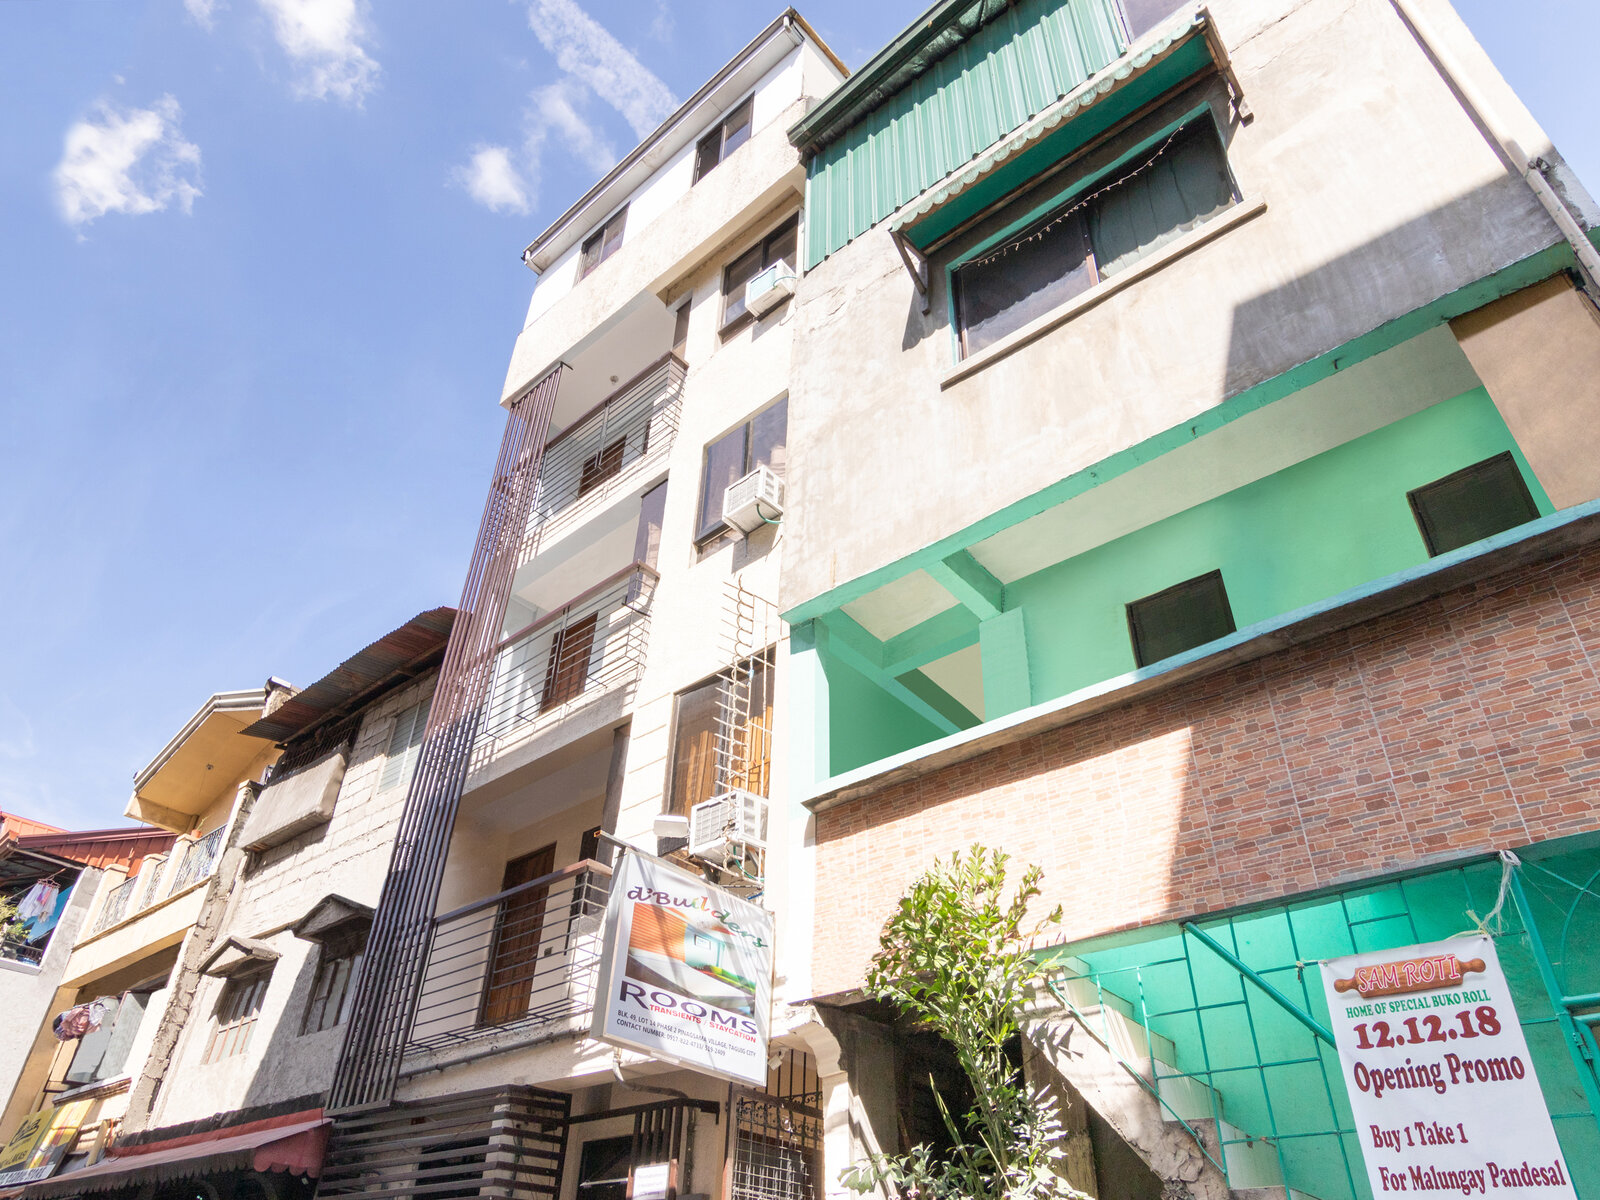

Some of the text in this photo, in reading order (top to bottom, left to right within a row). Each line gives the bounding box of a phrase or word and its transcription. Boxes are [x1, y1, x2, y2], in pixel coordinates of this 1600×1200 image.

[1358, 953, 1462, 993] SAM ROTI
[619, 980, 757, 1034] ROOMS
[1345, 988, 1492, 1019] HOME OF SPECIAL BUKO ROLL
[616, 1018, 642, 1032] CONTACT
[638, 1016, 649, 1024] LOT
[656, 1021, 673, 1033] PHASE
[746, 1049, 757, 1057] CITY
[649, 1004, 702, 1024] TRANSIENTS
[709, 1021, 757, 1043] STAYCATION
[1353, 1005, 1502, 1050] 12.12.18
[1353, 1052, 1526, 1099] Opening Promo
[1369, 1121, 1469, 1153] Buy 1 Take 1
[1378, 1158, 1567, 1196] For Malungay Pandesal
